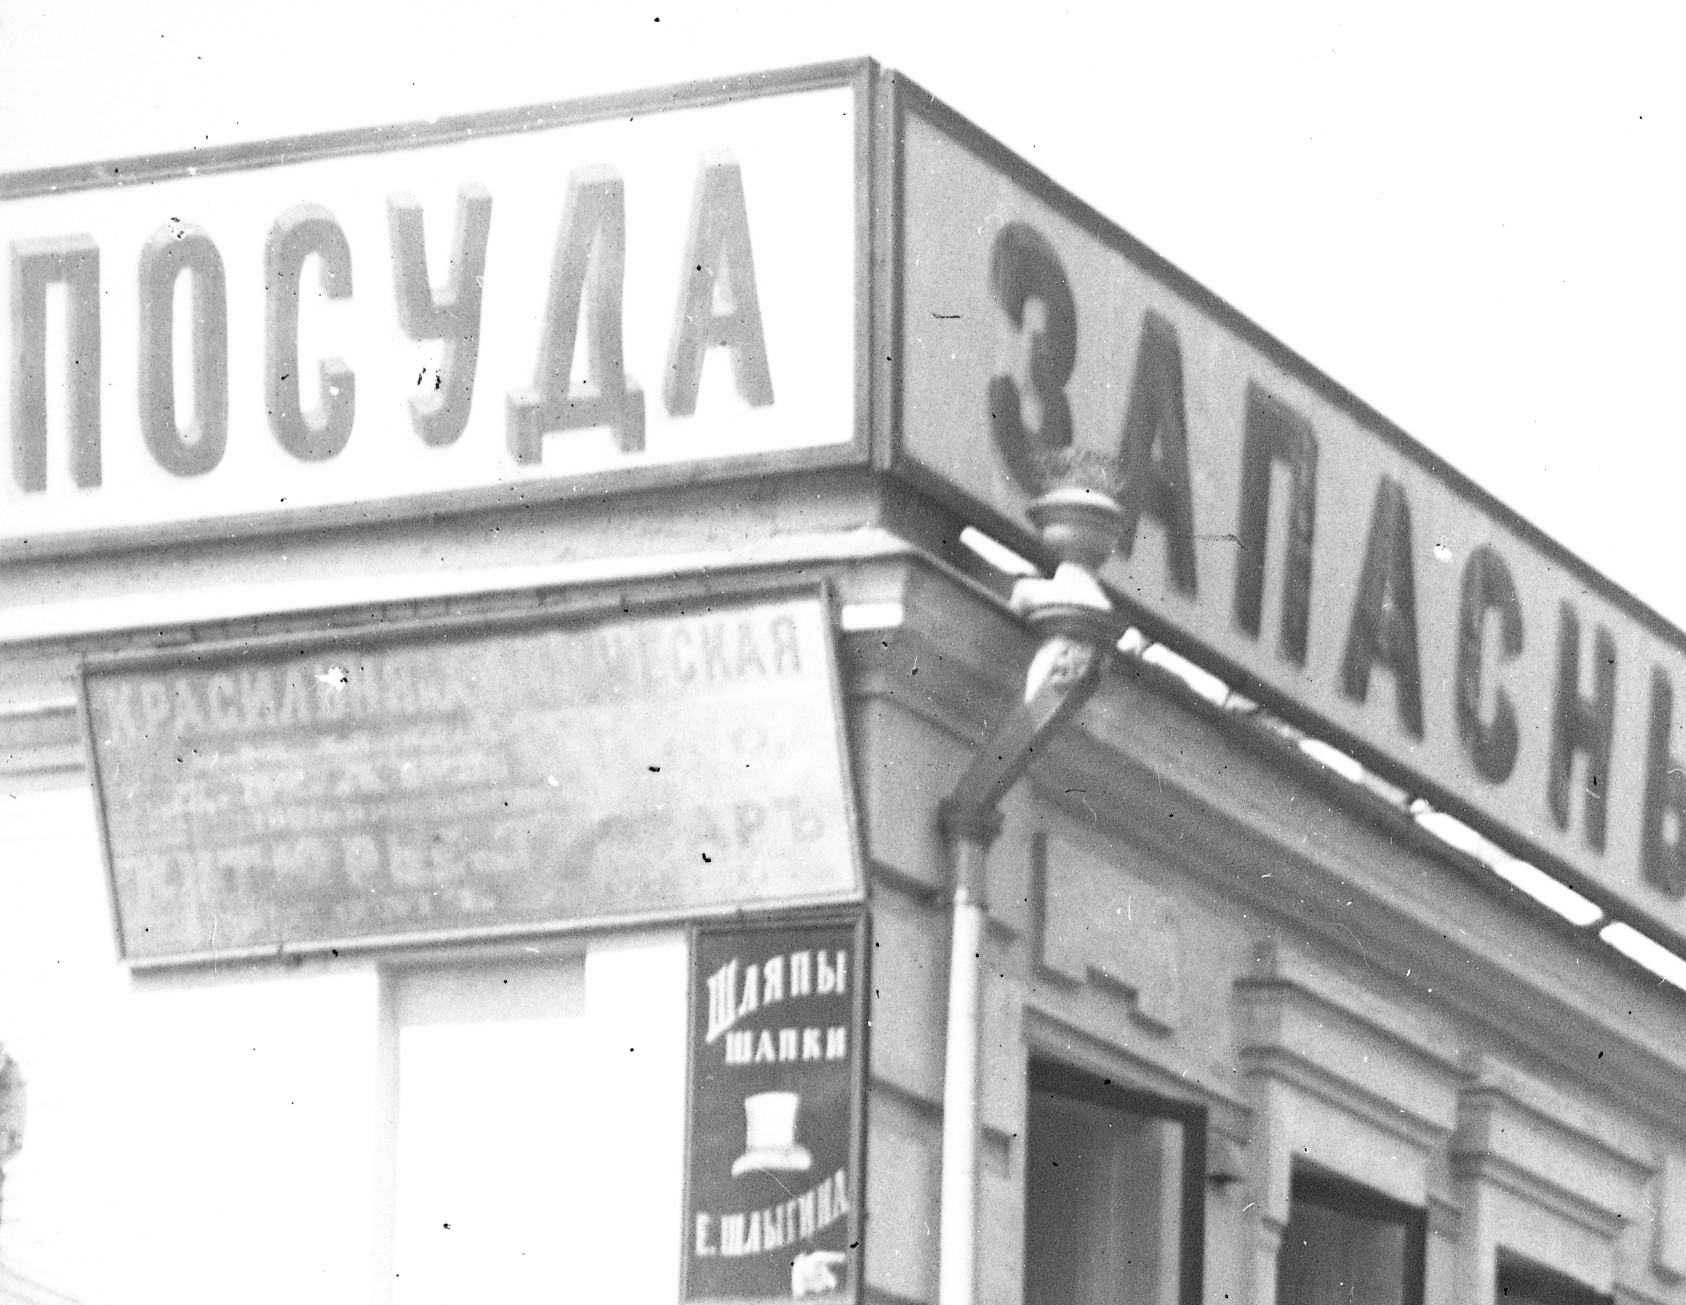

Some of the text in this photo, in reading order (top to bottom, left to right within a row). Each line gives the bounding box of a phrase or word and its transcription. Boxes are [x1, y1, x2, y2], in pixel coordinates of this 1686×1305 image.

[9, 146, 776, 494] ПОСУДА
[706, 956, 847, 1044] ШЛЯПЫ
[725, 1026, 847, 1065] ШАПКИ
